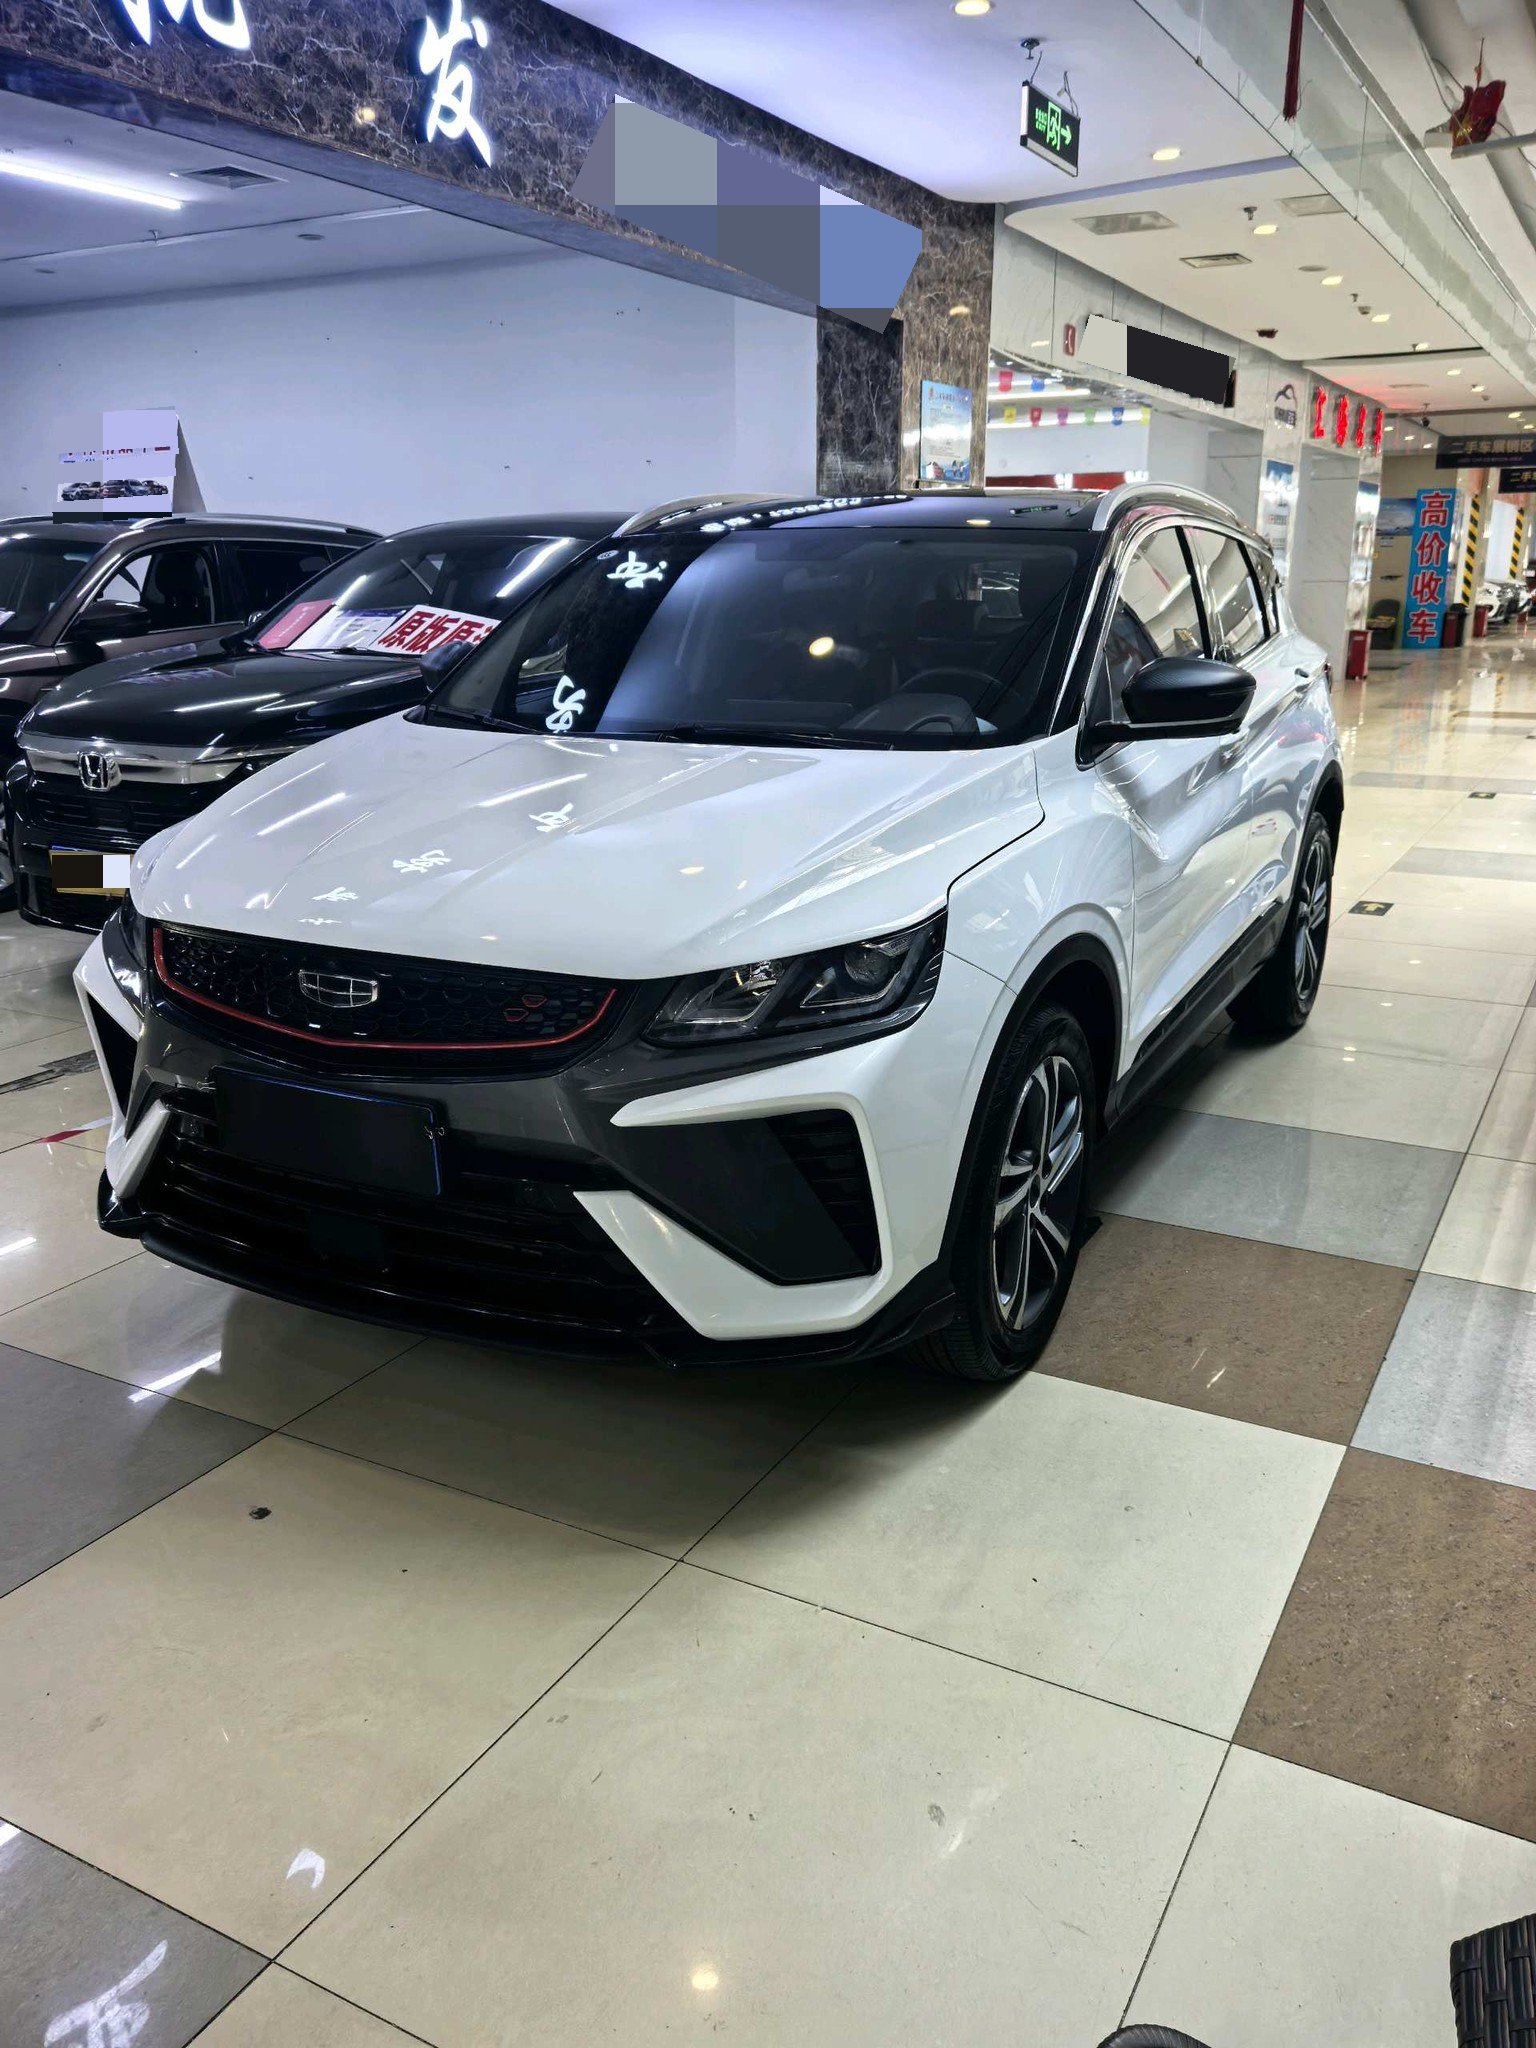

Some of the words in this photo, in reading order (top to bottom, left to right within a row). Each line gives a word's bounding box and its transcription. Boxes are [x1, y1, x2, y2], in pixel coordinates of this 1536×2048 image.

[1407, 491, 1451, 643] 高价收车
[377, 610, 494, 652] 原版原
